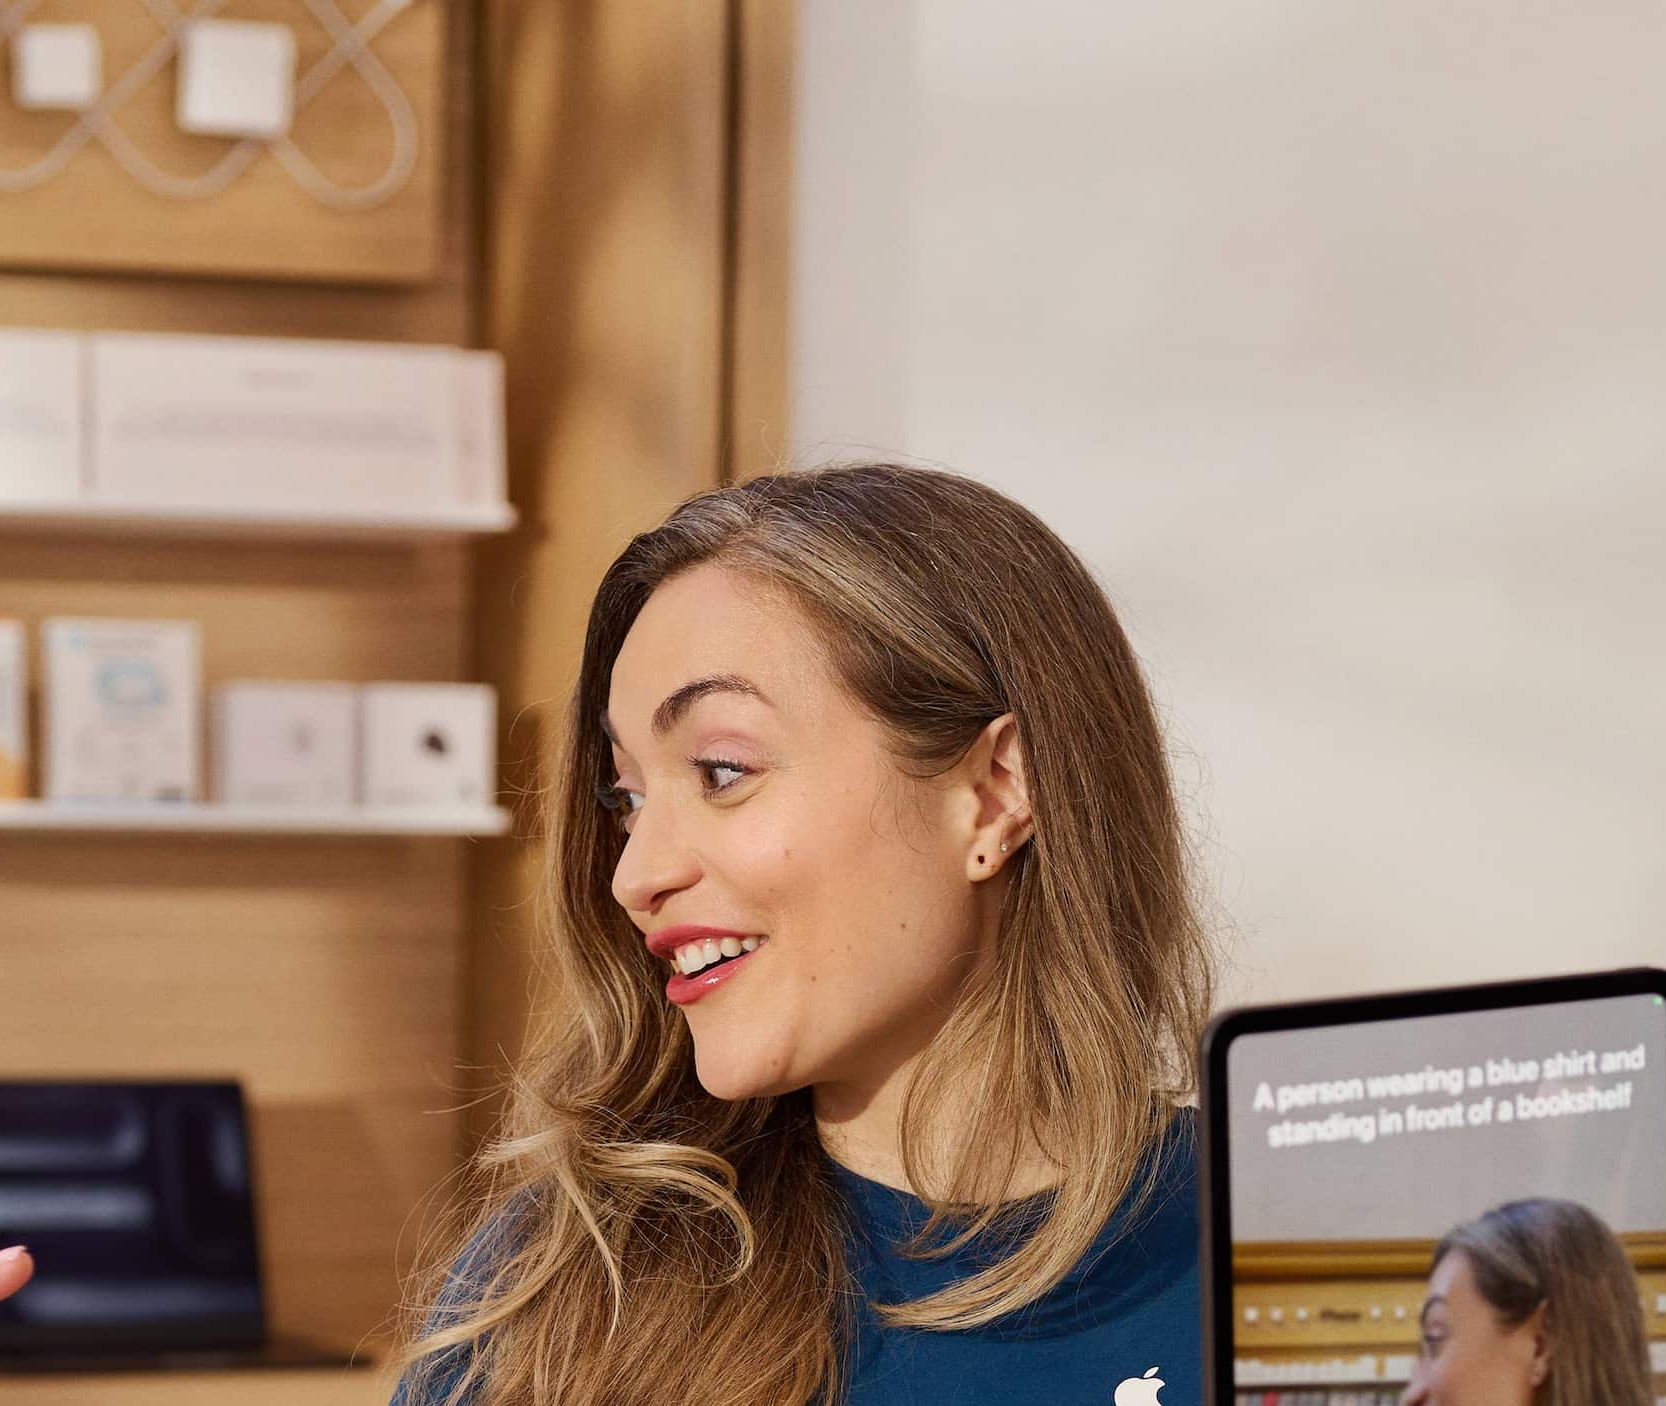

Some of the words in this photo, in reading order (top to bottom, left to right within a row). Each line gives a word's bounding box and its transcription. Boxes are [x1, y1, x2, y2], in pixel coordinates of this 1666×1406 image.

[1253, 1082, 1275, 1113] A
[1277, 1078, 1364, 1114] person
[1366, 1064, 1464, 1100] wearing
[1467, 1066, 1484, 1088] a
[1486, 1056, 1539, 1086] blue
[1542, 1049, 1597, 1080] shirt
[1599, 1043, 1645, 1074] and
[1267, 1112, 1376, 1149] standing
[1379, 1106, 1404, 1136] in
[1406, 1101, 1464, 1134] front
[1467, 1096, 1494, 1127] of
[1497, 1099, 1514, 1123] a
[1515, 1080, 1632, 1121] bookshelf
